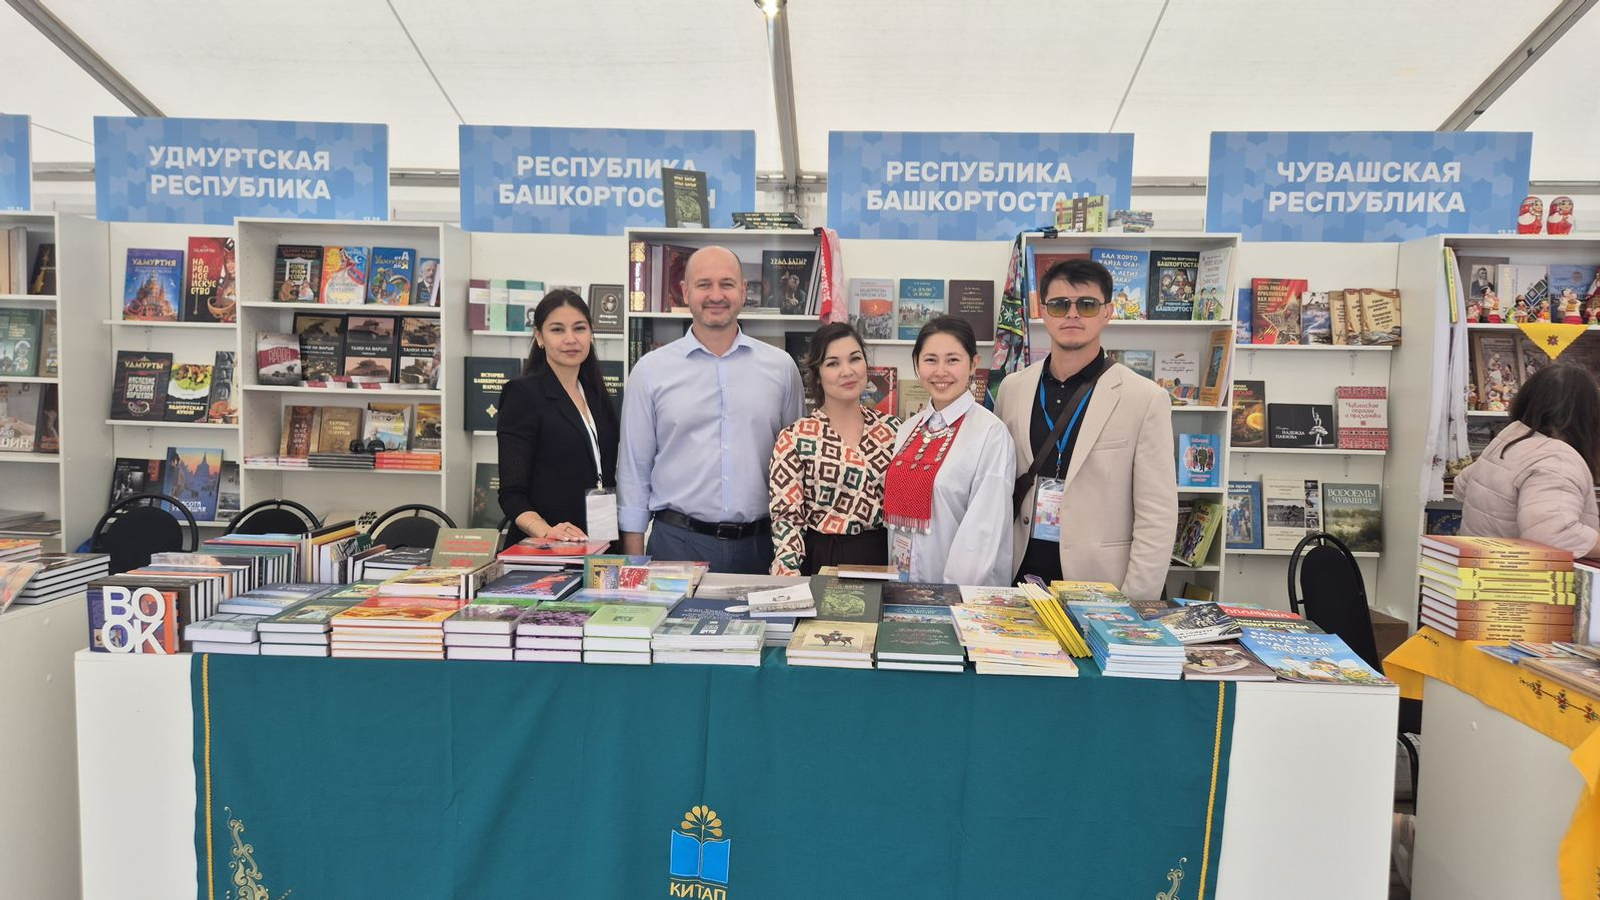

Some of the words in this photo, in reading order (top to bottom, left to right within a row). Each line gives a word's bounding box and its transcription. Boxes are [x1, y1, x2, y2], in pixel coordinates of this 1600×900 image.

[149, 146, 330, 171] УДМУРТСКАЯ
[886, 161, 1072, 183] РЕСПУБЛИКА
[1277, 162, 1461, 183] ЧУВАШСКАЯ
[151, 176, 331, 200] РЕСПУБЛИКА
[867, 190, 1089, 212] БАШКОРТОСТА
[1268, 192, 1466, 213] РЕСПУБЛИКА
[125, 361, 164, 369] УДМУРТЫ
[1328, 489, 1376, 497] ВОДОЕМЫ
[670, 882, 726, 900] КИТАП
